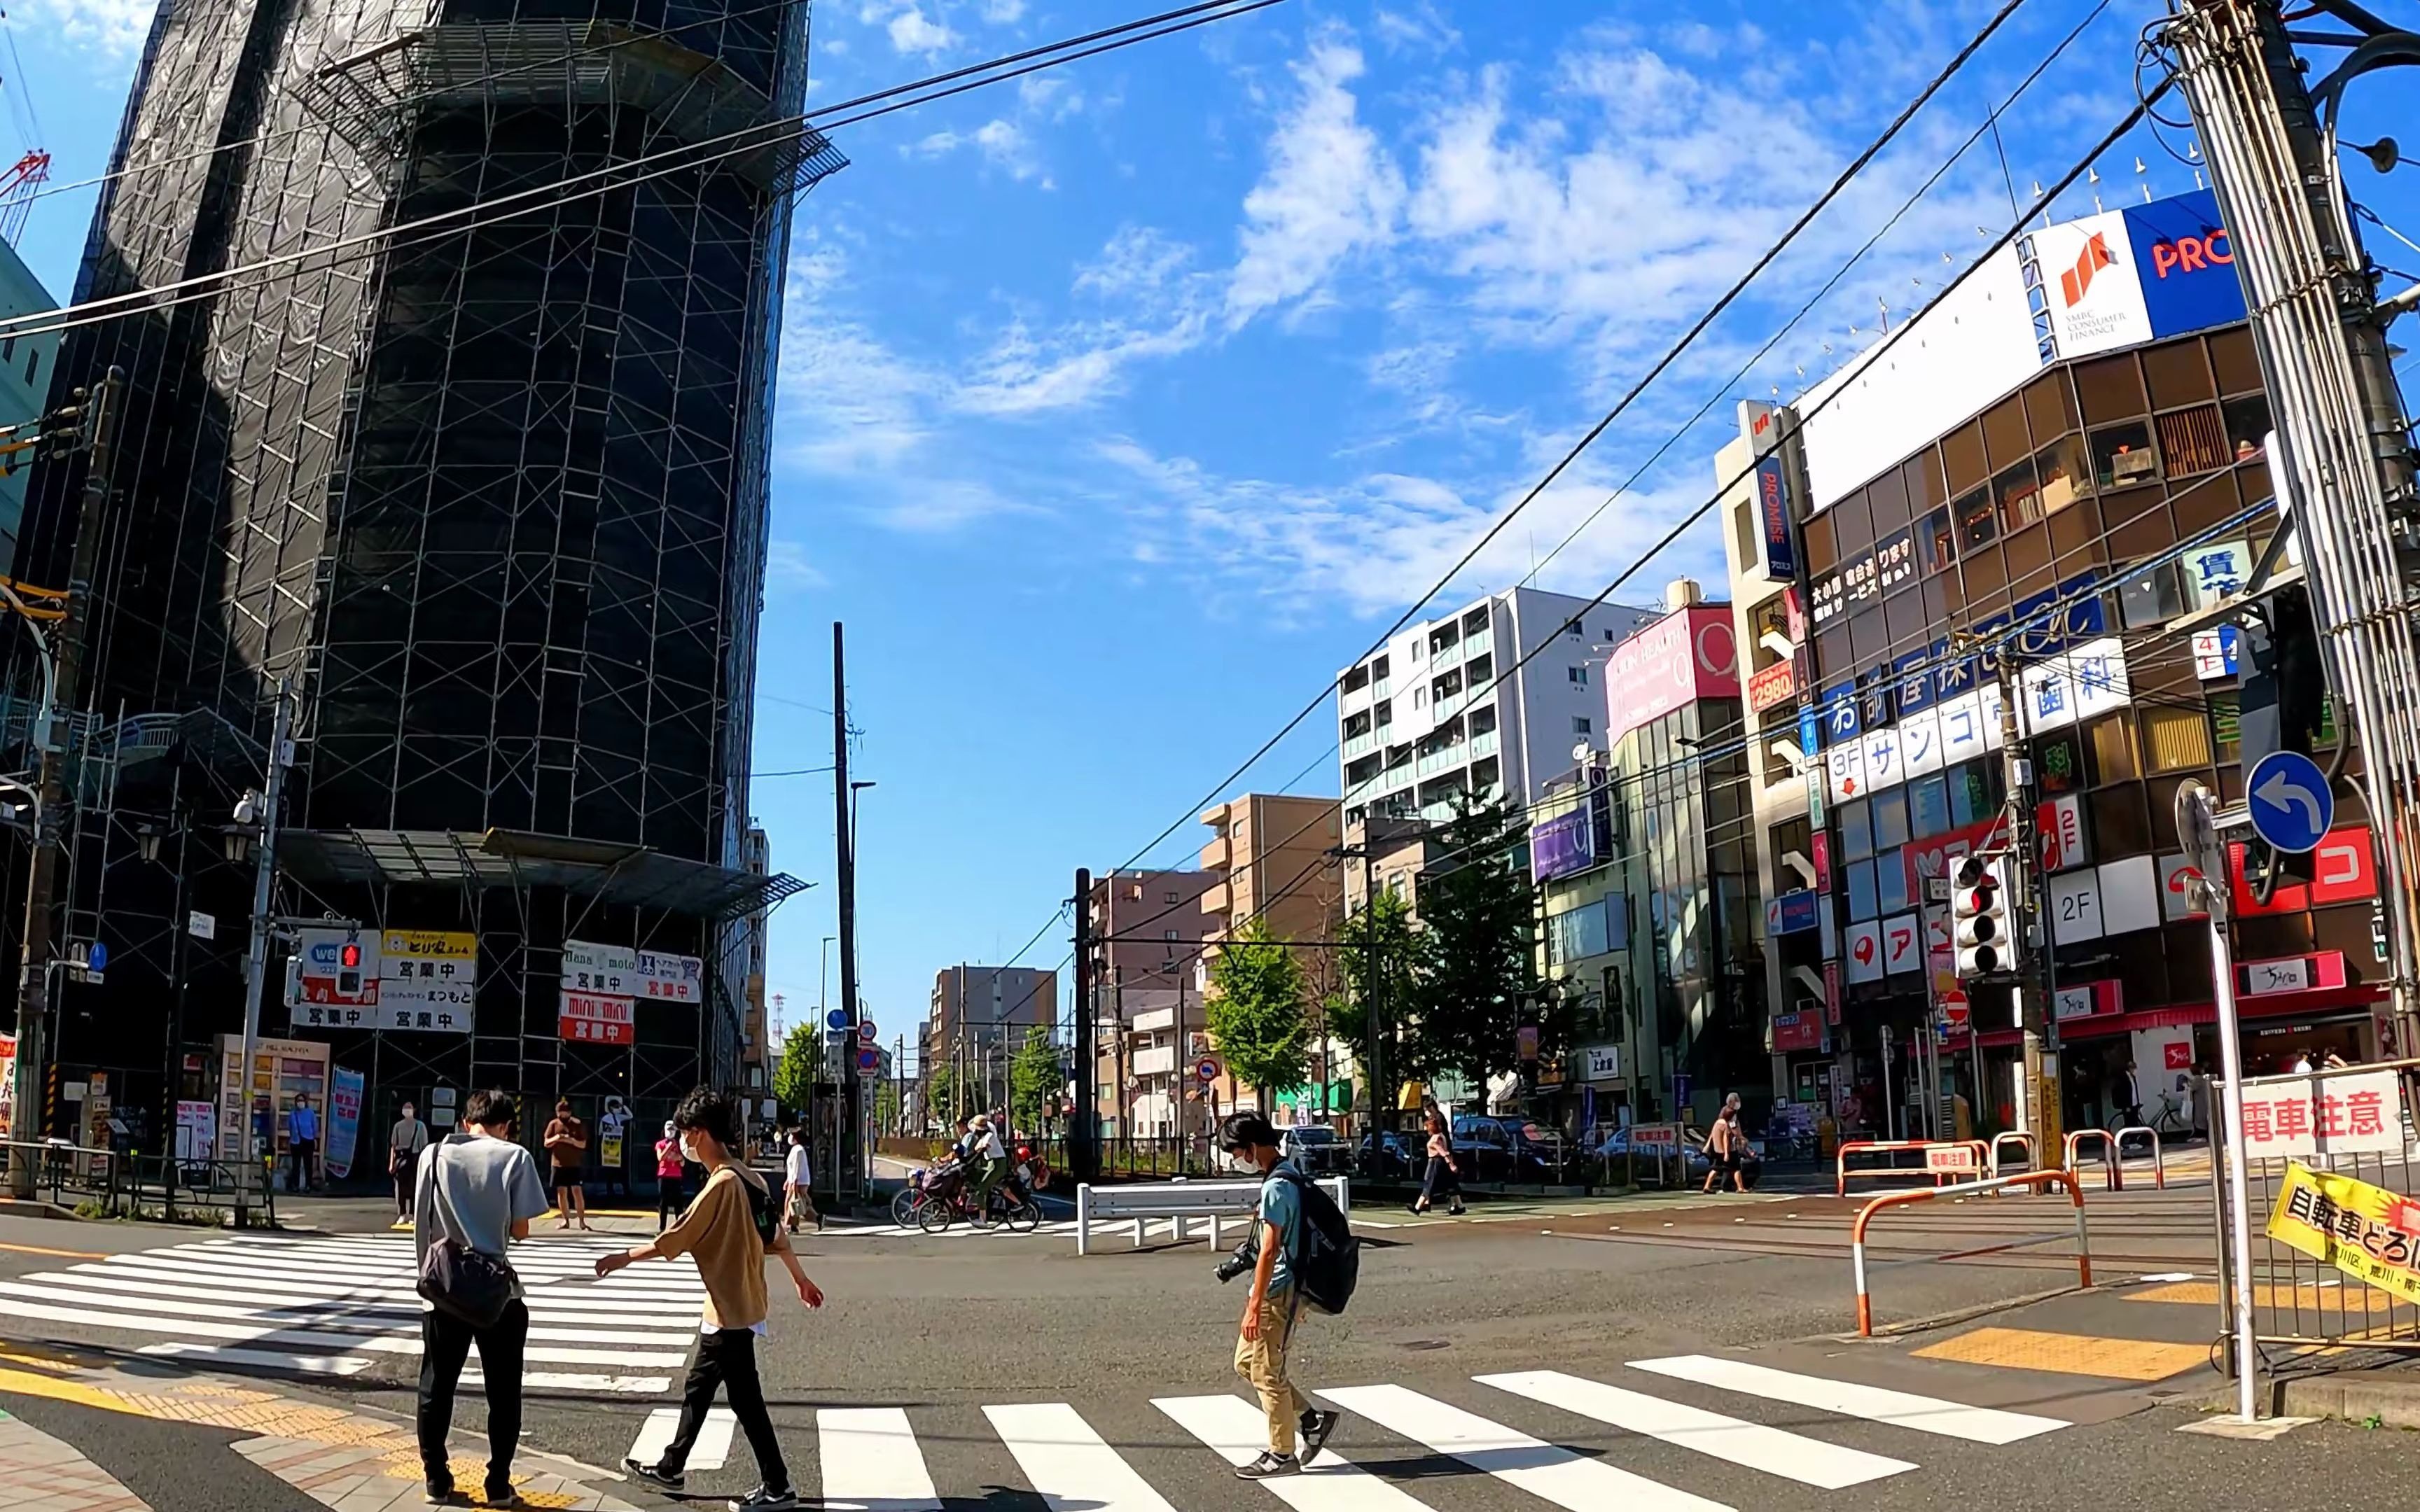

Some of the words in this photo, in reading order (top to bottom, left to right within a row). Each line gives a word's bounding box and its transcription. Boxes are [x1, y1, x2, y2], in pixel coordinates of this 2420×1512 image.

[2067, 312, 2129, 334] CONSUMER
[2069, 326, 2115, 342] FINANCE
[1762, 472, 1785, 544] PROMISE
[1754, 677, 1790, 708] 2980
[1833, 747, 1859, 777] 3F
[1872, 654, 2112, 776] サンコ歯科
[2061, 808, 2076, 853] 2F
[2062, 892, 2091, 922] 2F
[400, 961, 455, 979] 営業中
[609, 958, 635, 969] moto
[578, 972, 620, 991] 営業中
[648, 981, 688, 999] 営業中
[427, 990, 471, 1004] まつもと
[308, 1008, 361, 1026] 営業中
[569, 997, 594, 1017] mini
[603, 1002, 627, 1021] mini
[396, 1011, 452, 1029] 営業中
[576, 1021, 619, 1042] 営業中
[2243, 1090, 2384, 1143] 電車注意
